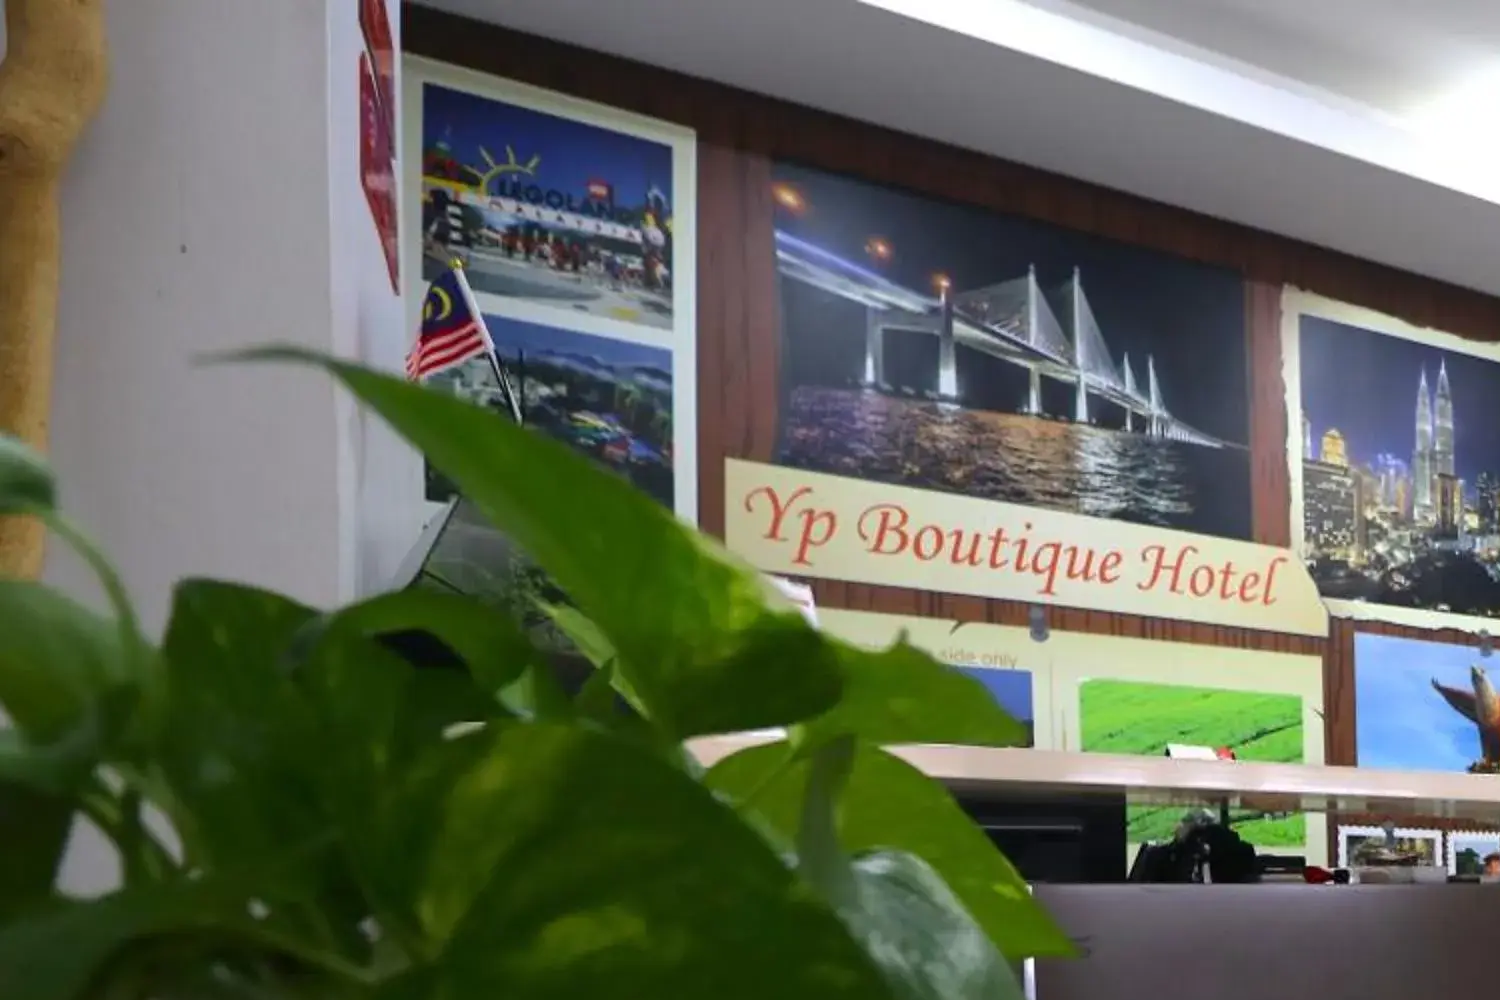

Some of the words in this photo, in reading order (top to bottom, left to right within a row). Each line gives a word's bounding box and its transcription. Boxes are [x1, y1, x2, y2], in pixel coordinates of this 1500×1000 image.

[743, 486, 836, 566] Yp
[857, 503, 1122, 596] Boutique
[1136, 545, 1288, 607] Hotel
